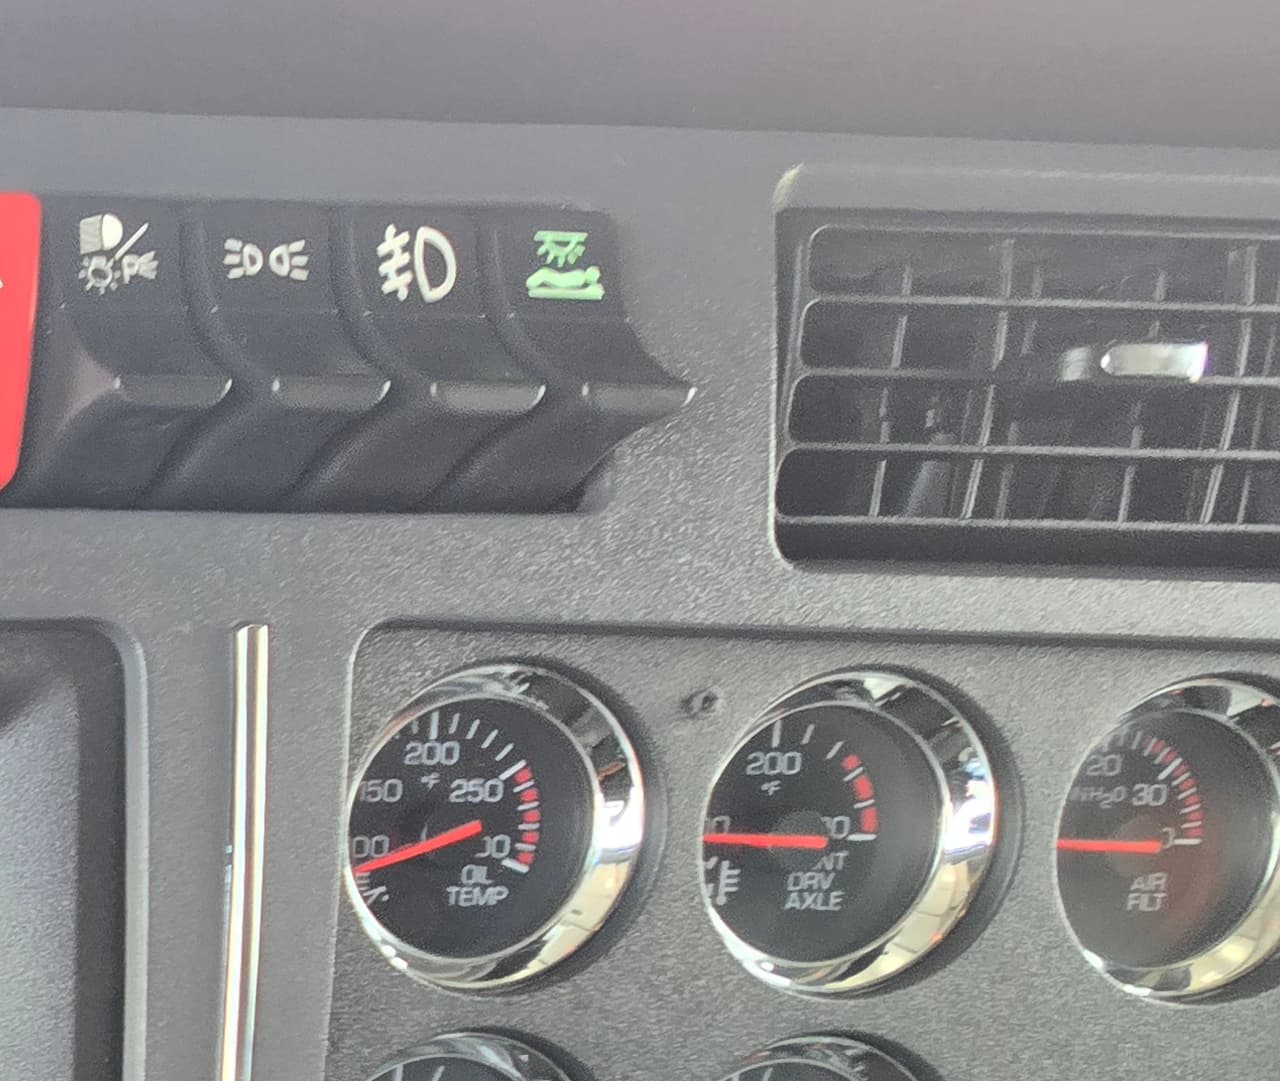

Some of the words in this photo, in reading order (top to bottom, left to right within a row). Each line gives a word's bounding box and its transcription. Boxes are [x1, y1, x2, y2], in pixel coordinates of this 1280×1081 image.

[404, 741, 460, 766] 200
[746, 751, 802, 775] 200
[1087, 754, 1122, 776] 20
[448, 778, 504, 804] 250
[1132, 783, 1168, 807] 30
[351, 834, 390, 858] 00
[461, 864, 493, 885] OIL
[786, 872, 836, 892] DRV
[1130, 872, 1168, 892] AIR
[446, 886, 509, 907] TEMP
[783, 891, 846, 911] AXLE
